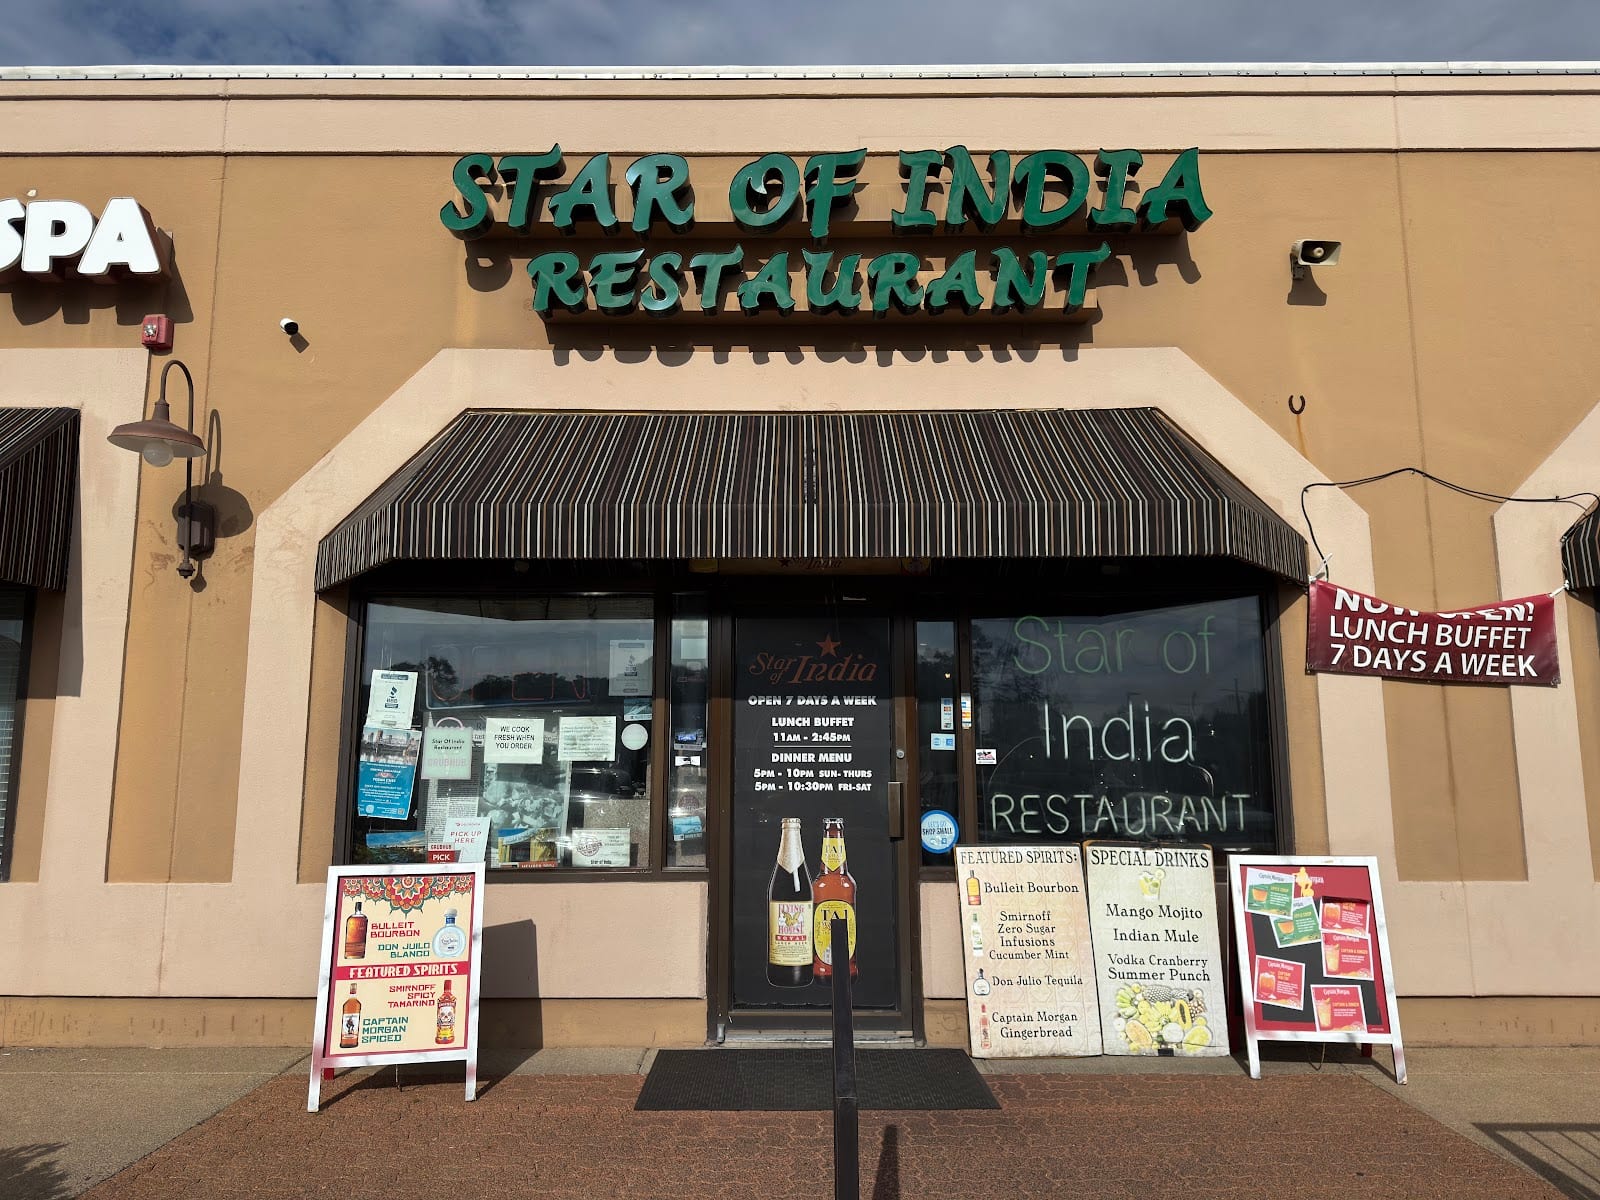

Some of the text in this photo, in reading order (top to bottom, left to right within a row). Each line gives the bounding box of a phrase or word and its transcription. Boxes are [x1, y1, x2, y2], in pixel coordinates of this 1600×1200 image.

[439, 143, 1213, 239] STAR OF INDIA
[527, 241, 1111, 312] RESTAURANT
[1334, 588, 1419, 617] NO
[1330, 615, 1532, 649] LUNCH BUFFET
[1013, 615, 1216, 674] Star of
[748, 652, 797, 675] Star
[1330, 643, 1538, 678] 7 DAYS A WEEK
[788, 653, 878, 684] India
[770, 667, 787, 685] of
[748, 695, 877, 706] OPEN 7 DAYS A WEEK
[771, 717, 854, 727] LUNCH BUFFET
[773, 732, 801, 742] 11AM
[811, 732, 851, 742] 2:45PM
[1044, 700, 1195, 763] India
[510, 742, 533, 750] ORDER
[771, 753, 852, 763] DINNER MENU
[753, 768, 775, 778] 5PM
[786, 768, 814, 778] 10PM
[843, 770, 872, 778] THURS
[754, 781, 776, 791] 5PM
[787, 781, 833, 791] 10:30PM
[838, 783, 872, 791] FRI-SAT
[991, 793, 1251, 836] RESTAURANT
[960, 850, 1078, 865] FEATURED SPIRITS:
[1091, 849, 1209, 868] SPECIAL DRINKS
[984, 882, 1079, 893] Bulleit Bourbon
[1000, 911, 1051, 921] Smirnoff
[1105, 903, 1203, 921] Mango Mojito
[371, 921, 415, 930] BULLEIT
[998, 923, 1056, 935] Zero Sugar
[370, 930, 420, 938] BOURBON
[1113, 928, 1199, 943] Indian Mule
[377, 943, 399, 951] DON
[1000, 936, 1055, 947] Infusions
[390, 950, 430, 958] BLANCO
[989, 949, 1069, 960] Cucumber Mint
[1107, 953, 1208, 968] Vodka Cranberry
[349, 963, 458, 979] FEATURED SPIRITS
[1108, 967, 1211, 981] Summer Punch
[992, 975, 1083, 987] Don Julio Tequila
[389, 984, 436, 993] SMIRNOFF
[407, 992, 436, 1000] SPICY
[387, 999, 435, 1008] TAMARIND
[362, 1016, 409, 1026] CAPTAIN
[992, 1011, 1078, 1024] Captain Morgan
[362, 1026, 407, 1035] MORGAN
[1000, 1026, 1072, 1040] Gingerbread
[361, 1035, 402, 1044] SPICED
